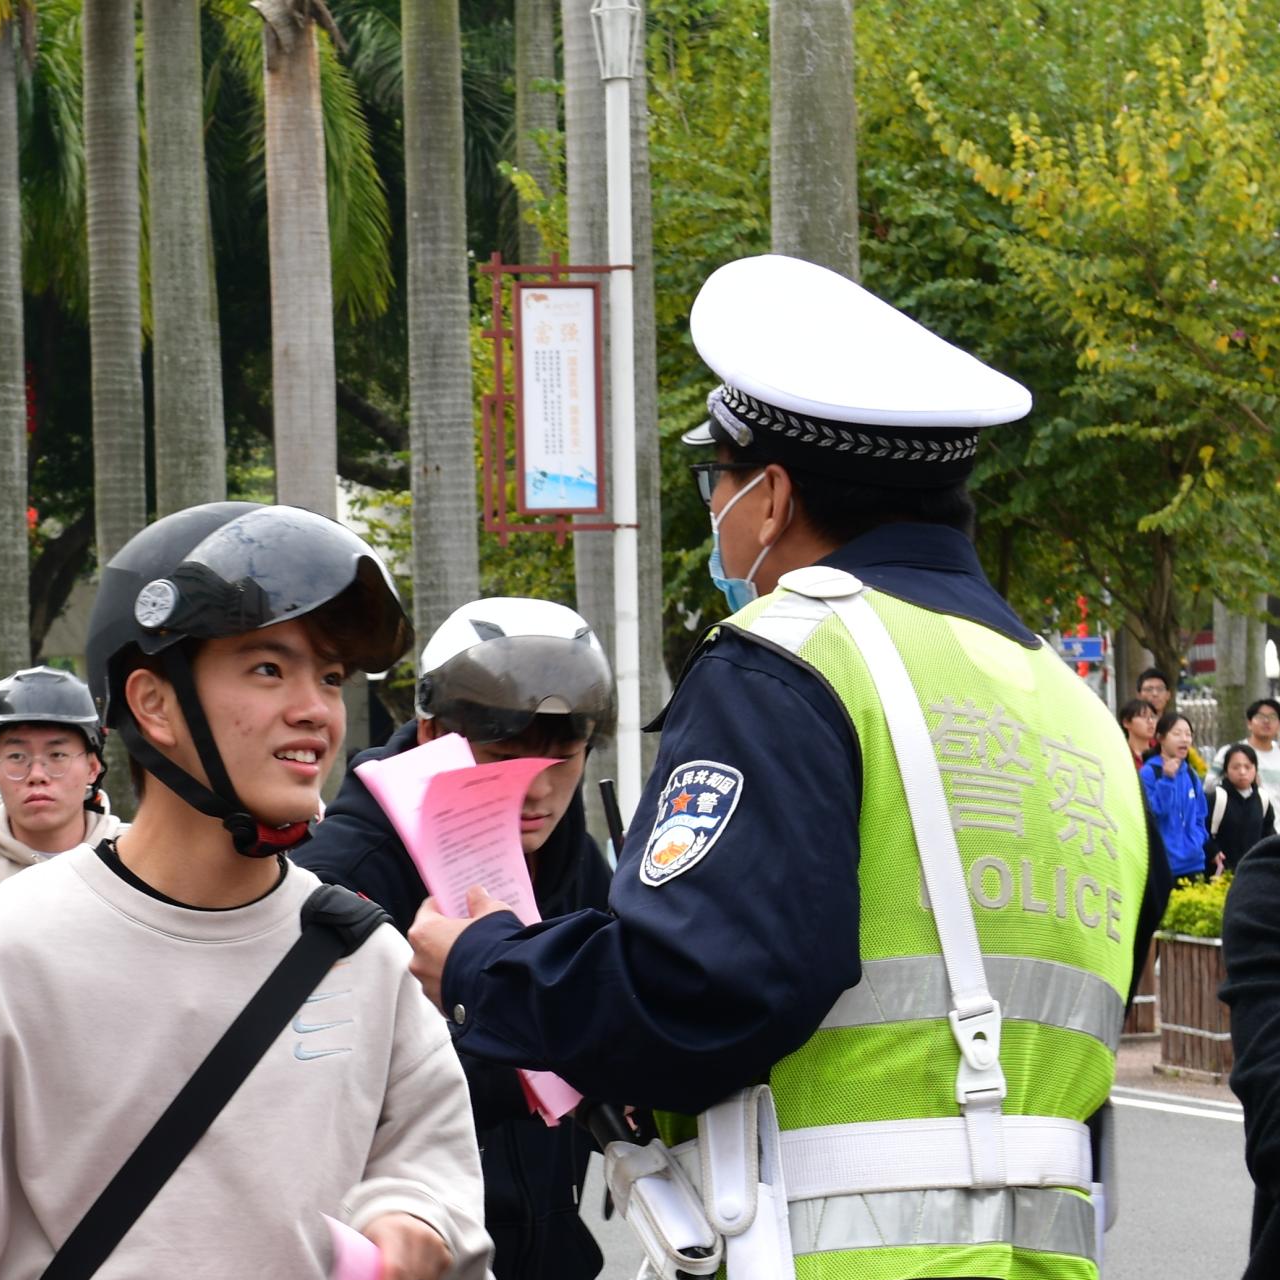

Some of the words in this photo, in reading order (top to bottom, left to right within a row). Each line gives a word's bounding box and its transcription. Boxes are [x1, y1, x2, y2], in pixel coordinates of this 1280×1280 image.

[665, 769, 737, 795] 人民共和国
[928, 696, 1118, 858] 警察
[920, 857, 1122, 943] OLICE
